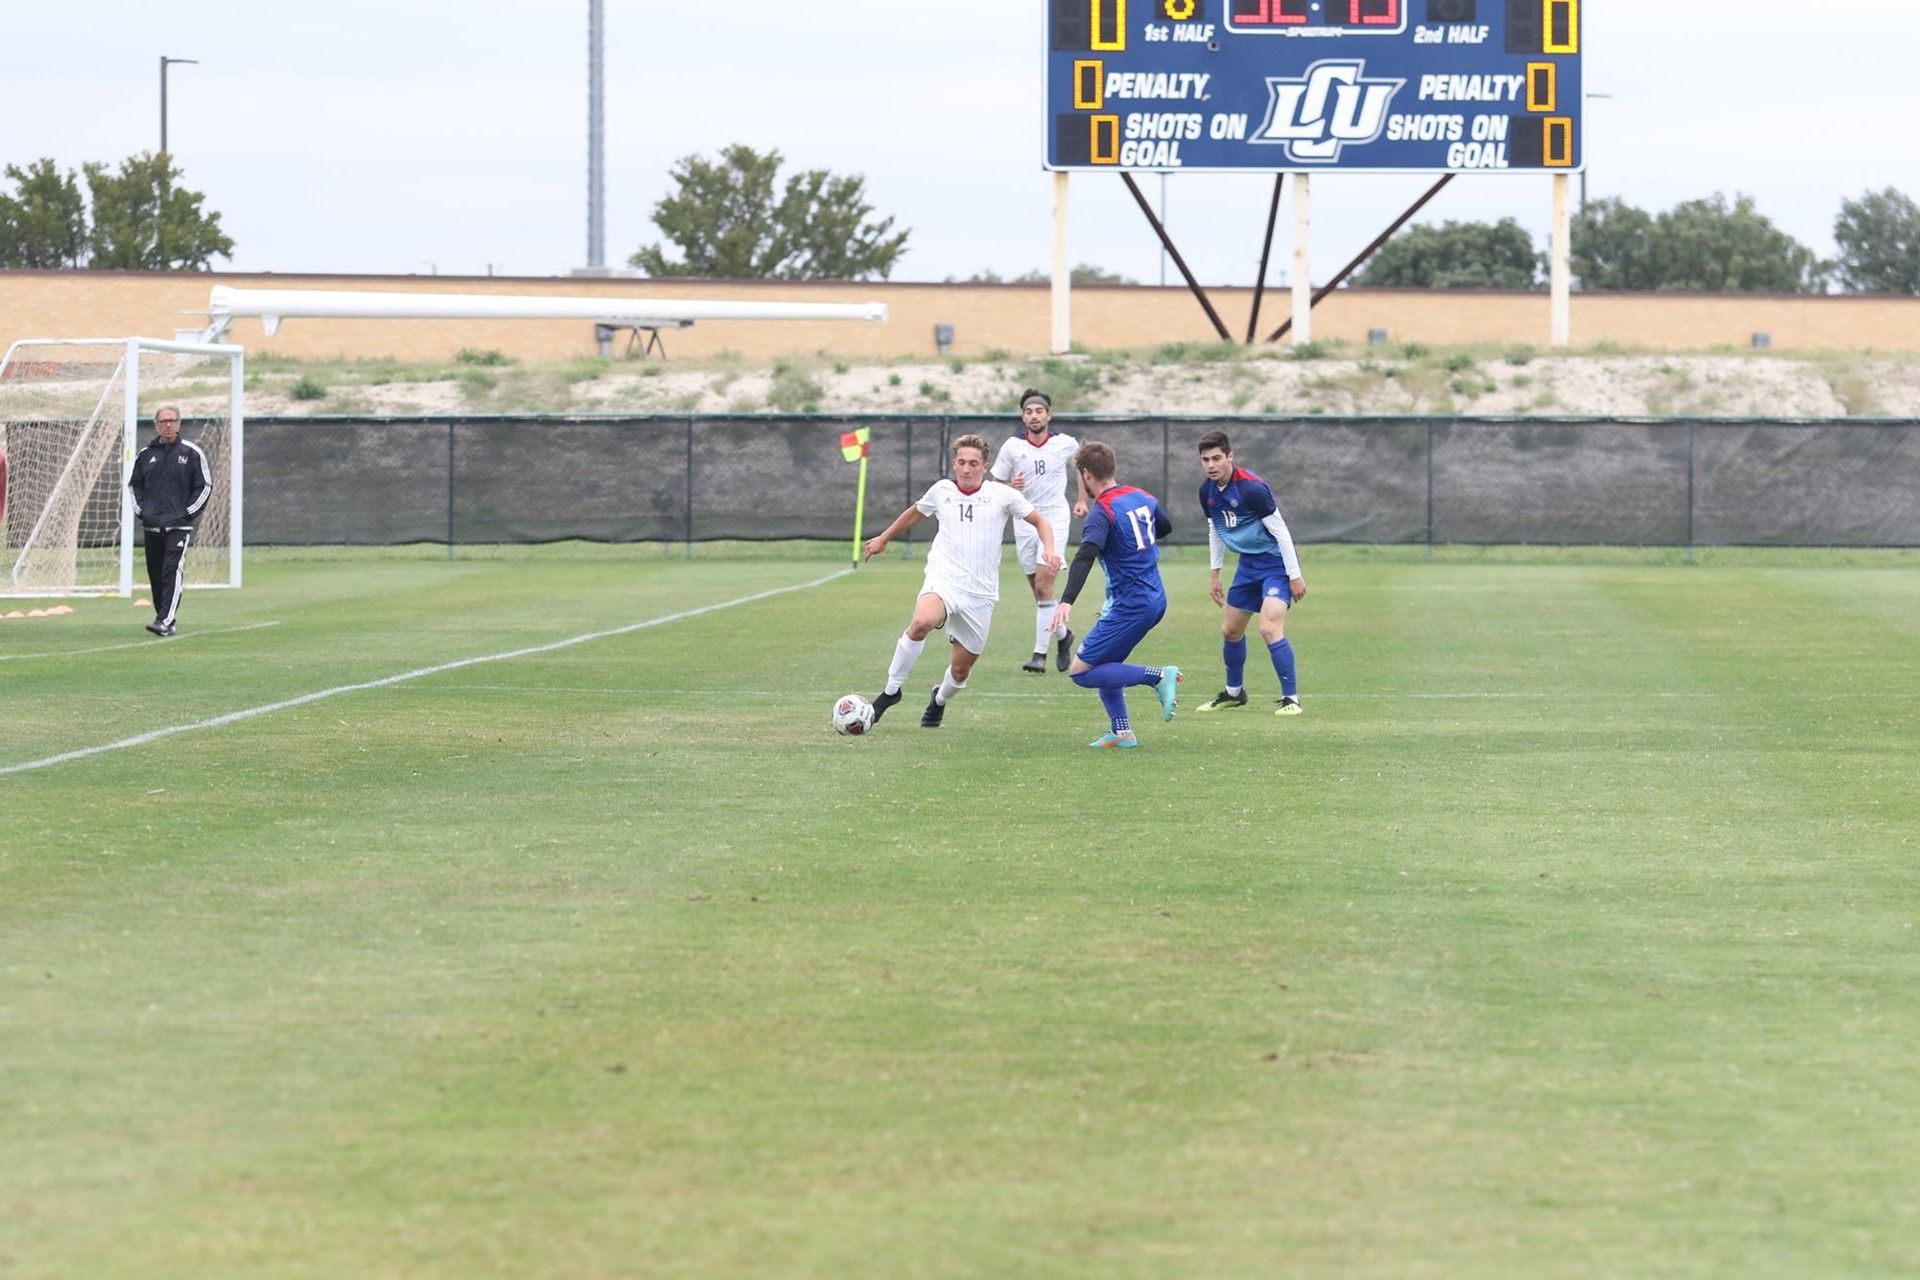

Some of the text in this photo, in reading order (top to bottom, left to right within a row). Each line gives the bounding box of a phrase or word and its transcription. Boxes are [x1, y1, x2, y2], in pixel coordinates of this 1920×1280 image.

[1144, 23, 1215, 42] 1st HALF
[1413, 26, 1489, 44] 2nd HALF
[1074, 60, 1103, 109] 0
[1104, 72, 1211, 99] PENALTY
[1418, 75, 1525, 100] PENALTY
[1526, 62, 1556, 112] 0
[1262, 65, 1395, 158] LCU
[1090, 115, 1119, 164] 0
[1124, 113, 1248, 140] SHOTS ON
[1386, 115, 1509, 141] SHOTS ON
[1120, 140, 1182, 167] GOAL
[1446, 142, 1509, 168] GOAL
[1543, 117, 1572, 166] 0
[1034, 459, 1046, 476] 18
[959, 503, 973, 522] 14
[1125, 505, 1155, 550] 17
